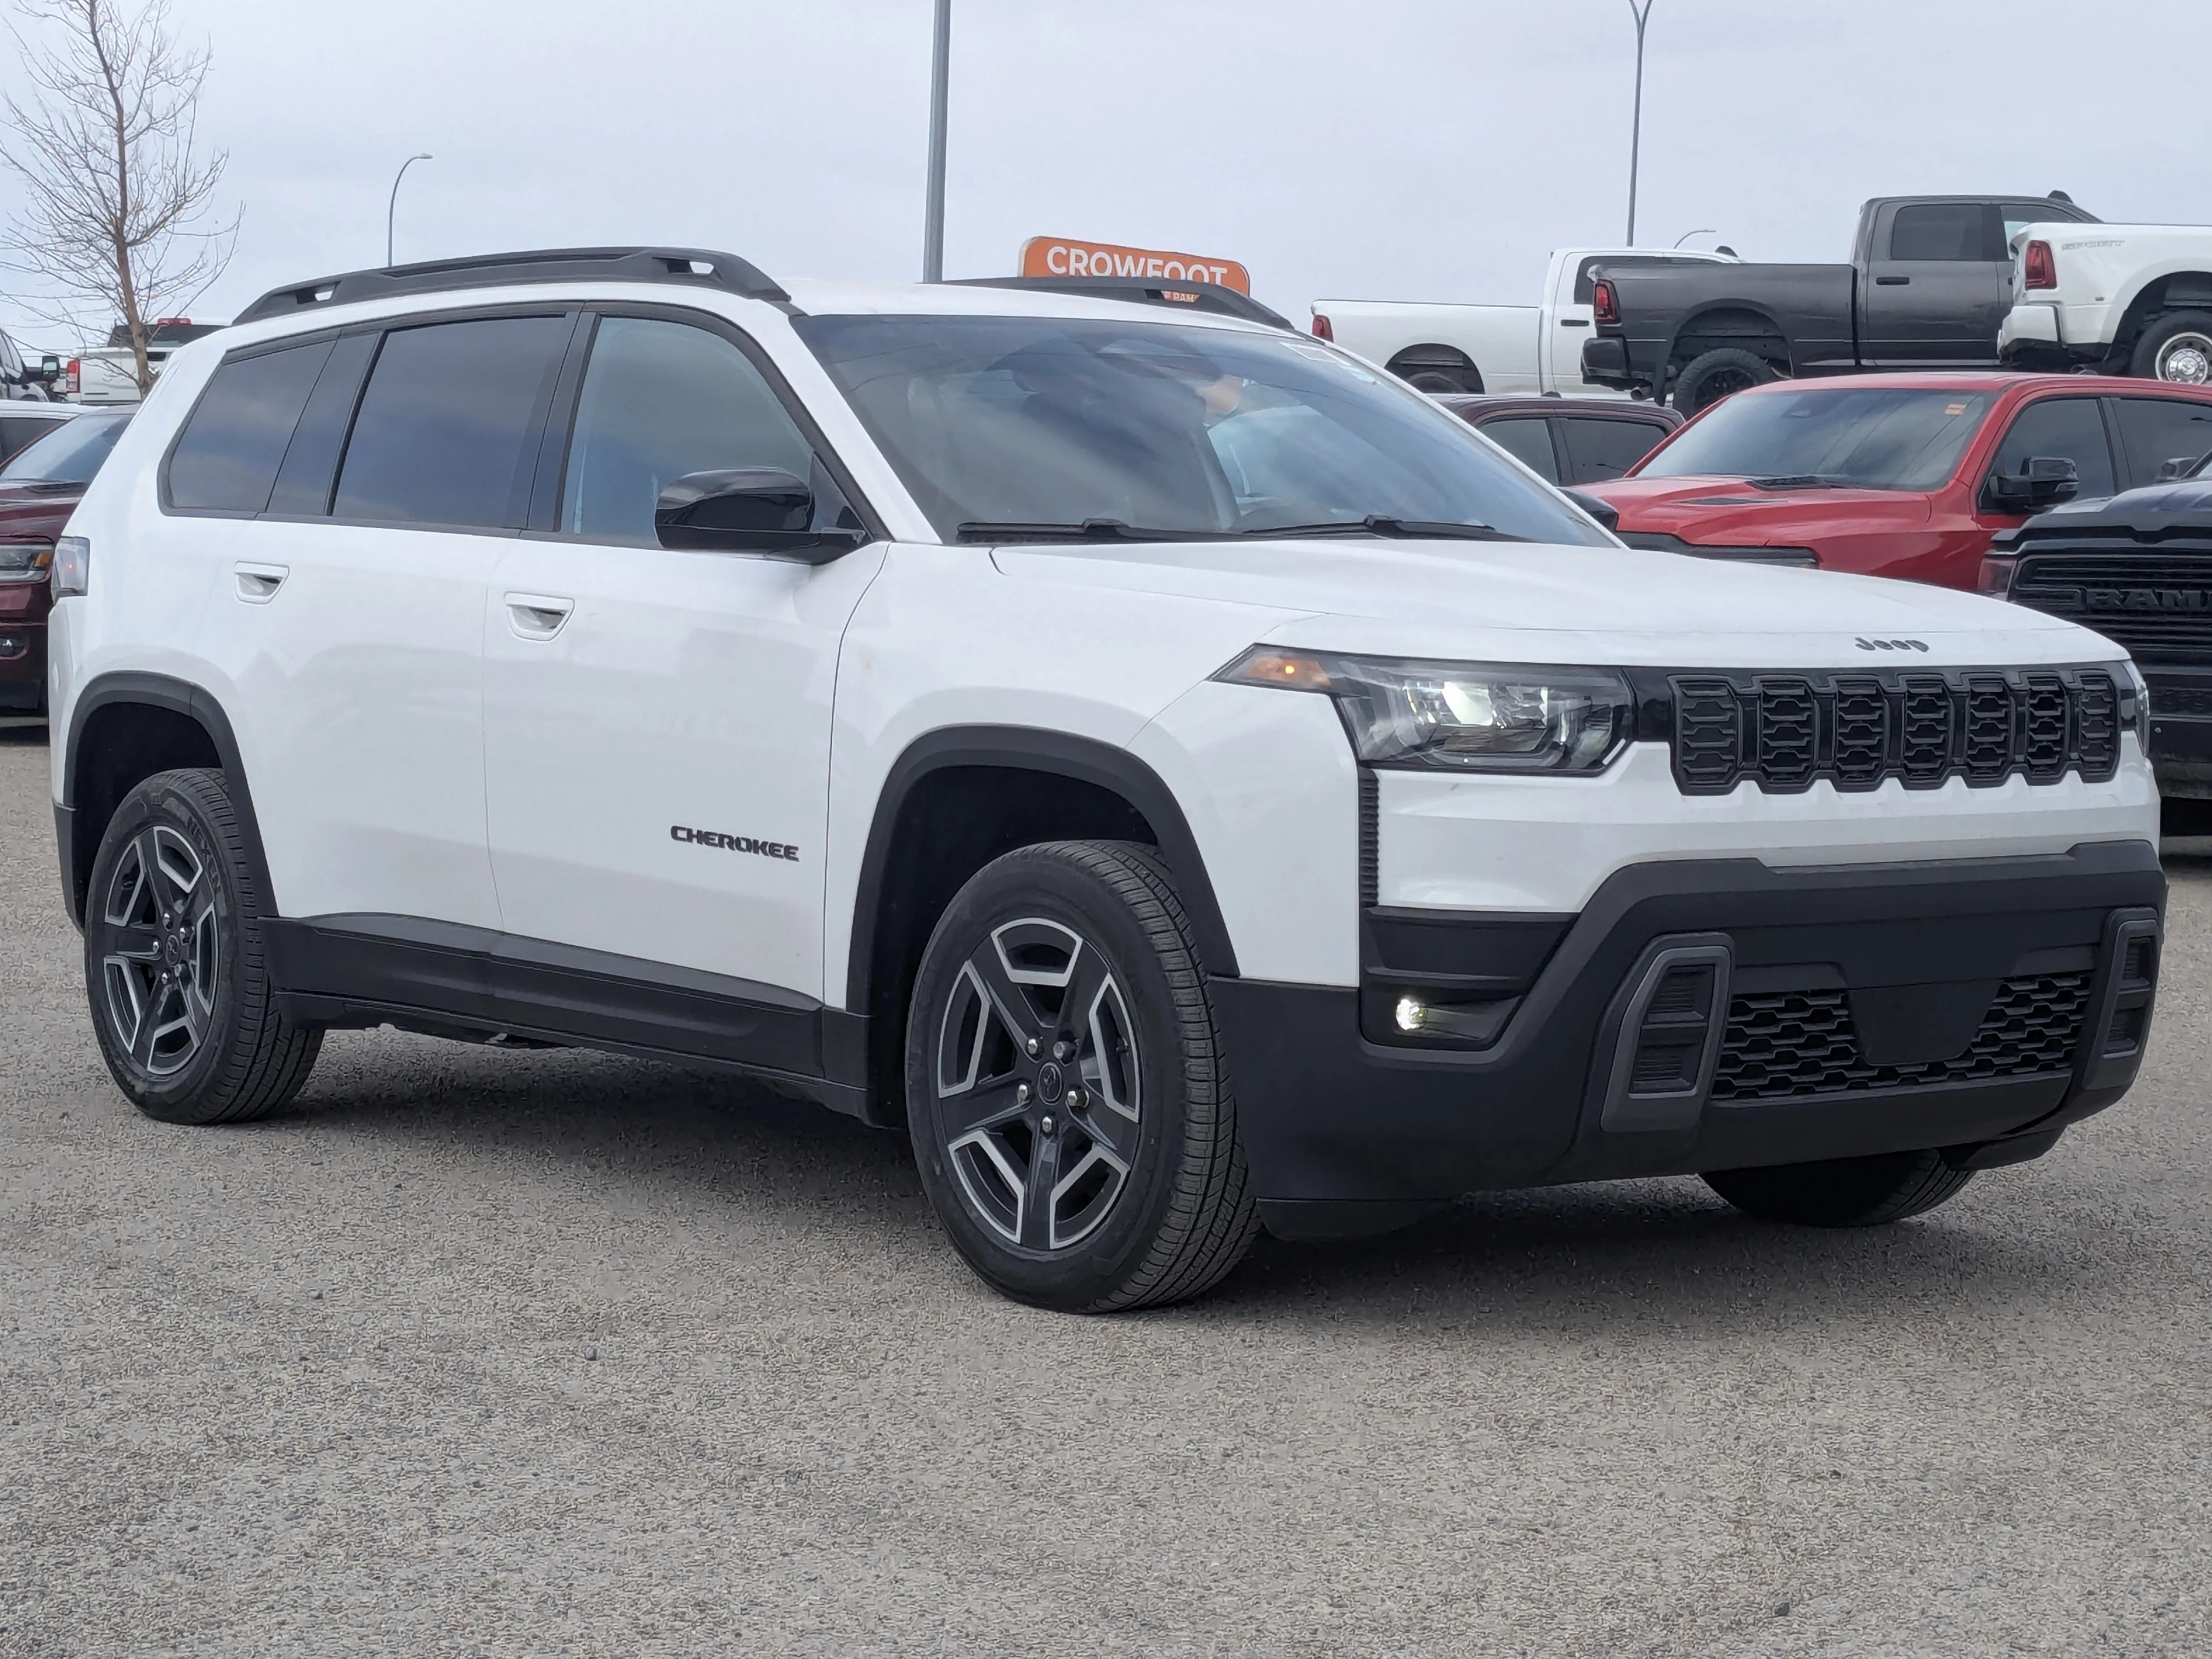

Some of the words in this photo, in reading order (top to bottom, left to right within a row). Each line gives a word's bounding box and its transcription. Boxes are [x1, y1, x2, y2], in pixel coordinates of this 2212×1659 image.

[1047, 246, 1227, 285] CROWFOOT
[2086, 588, 2202, 611] RAM
[1855, 637, 1929, 652] Jeep
[670, 825, 799, 862] CHEROKEE
